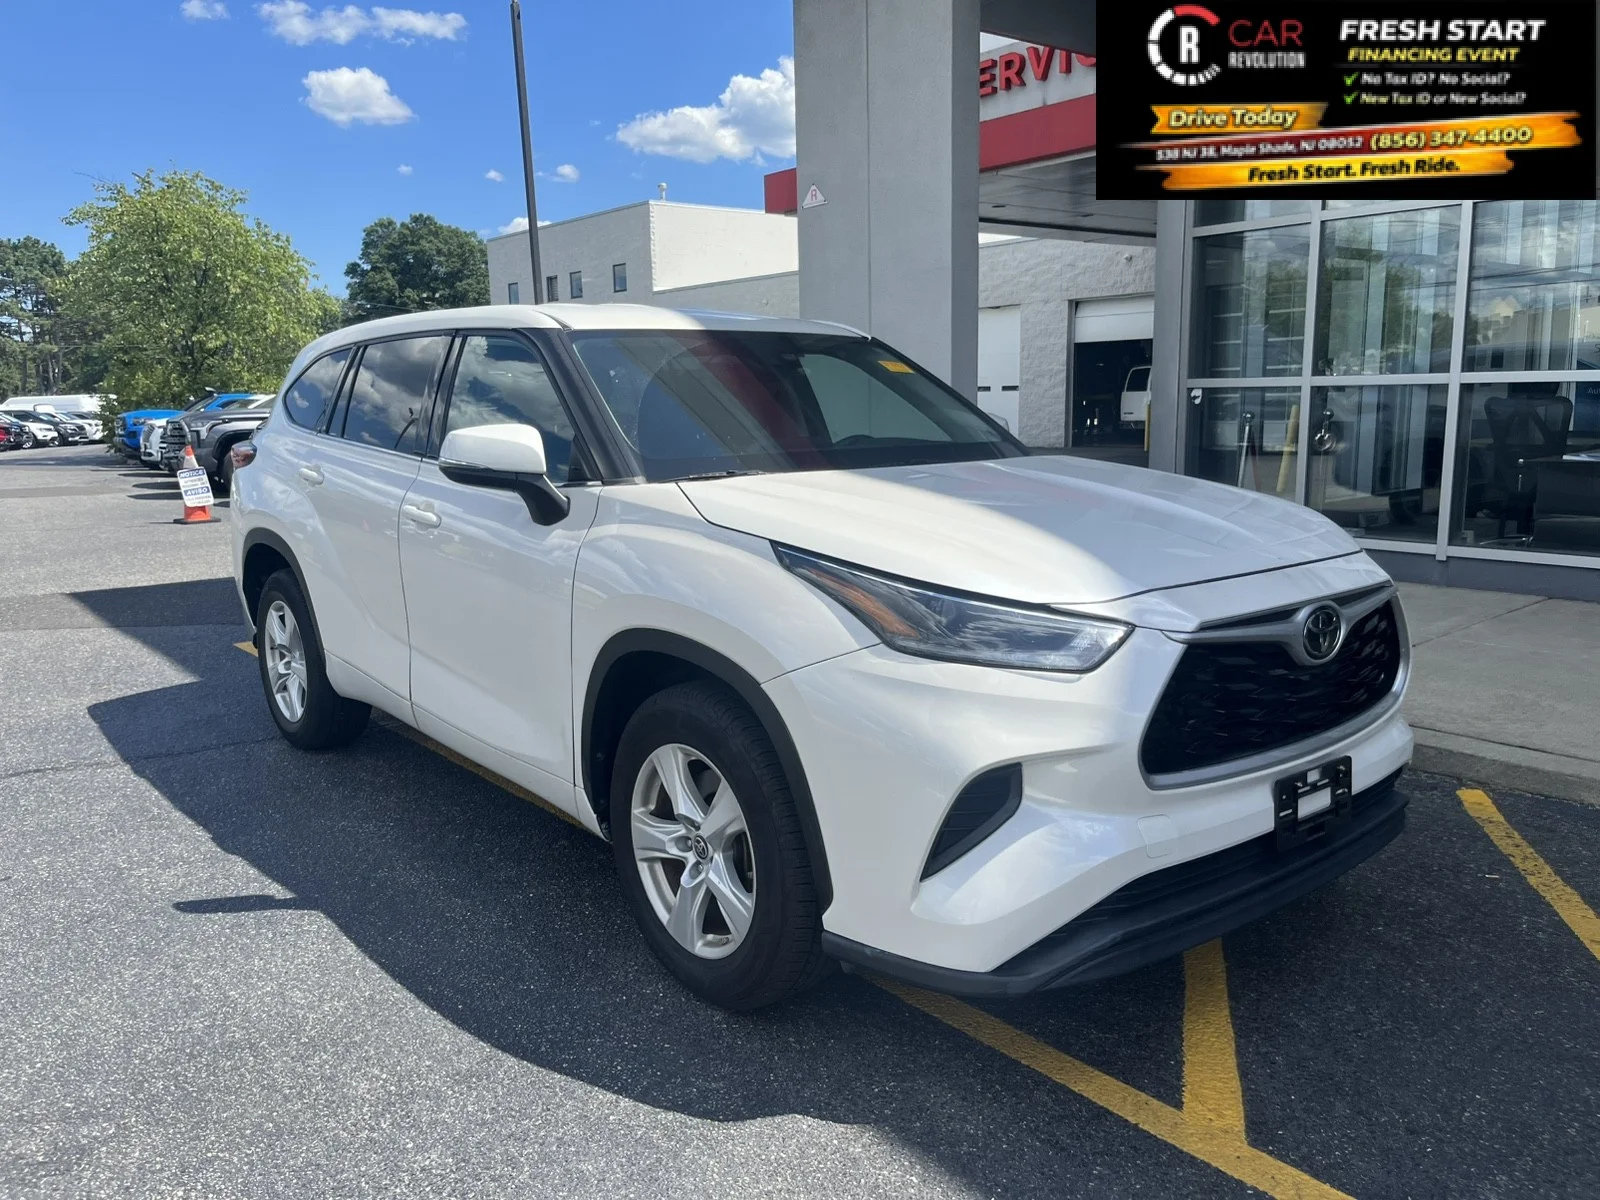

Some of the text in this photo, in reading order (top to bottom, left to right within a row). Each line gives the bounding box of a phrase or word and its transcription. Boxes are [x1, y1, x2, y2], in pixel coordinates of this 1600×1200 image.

[980, 46, 1096, 97] ERVI
[180, 470, 203, 478] NOTICE
[187, 488, 207, 496] AVISO
